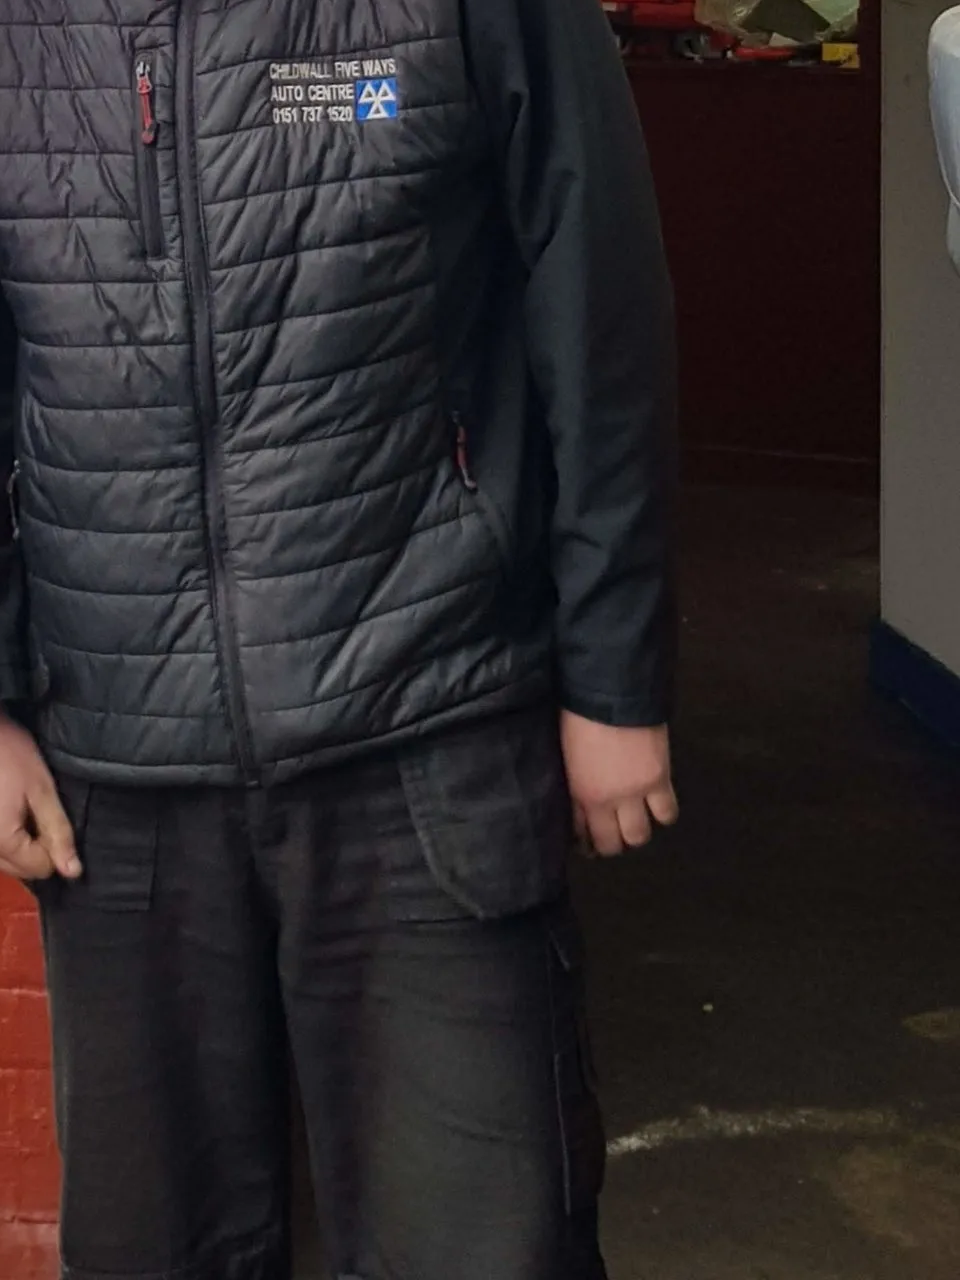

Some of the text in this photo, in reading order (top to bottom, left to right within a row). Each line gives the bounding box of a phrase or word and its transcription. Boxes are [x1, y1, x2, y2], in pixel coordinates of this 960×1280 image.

[269, 58, 396, 80] CHILDWALL FIVE WAYS
[271, 84, 354, 102] AUTO CENTRE
[272, 106, 353, 124] 0151 737 1520
